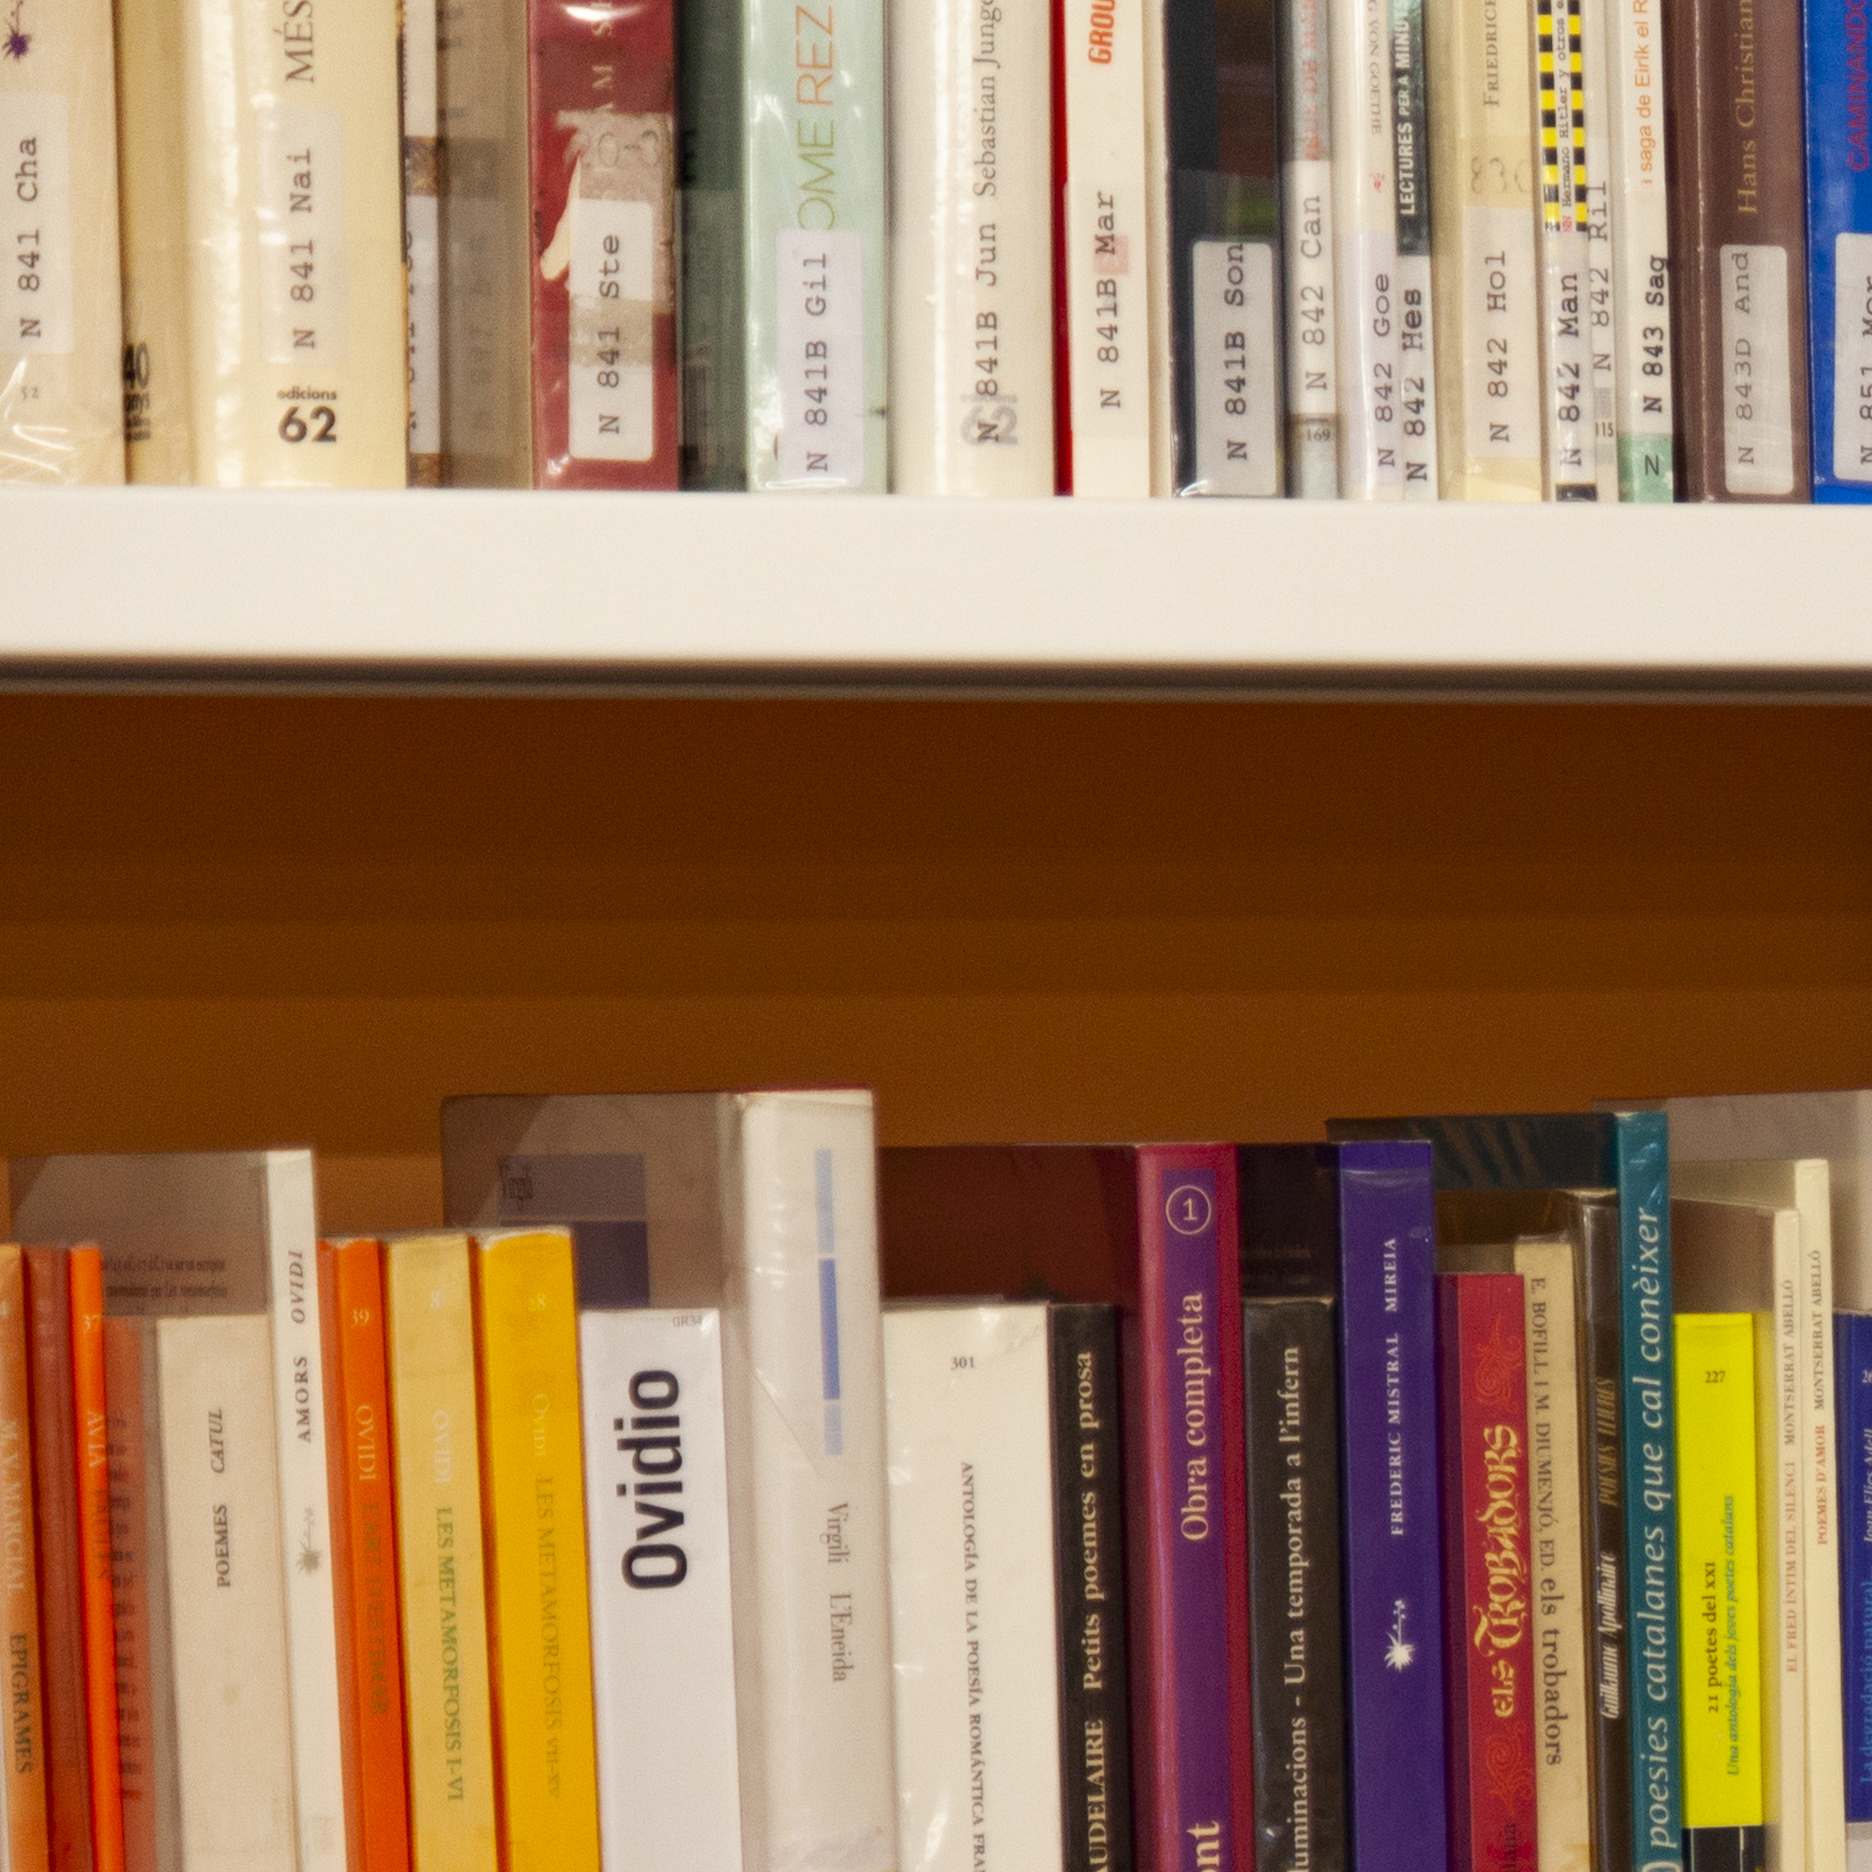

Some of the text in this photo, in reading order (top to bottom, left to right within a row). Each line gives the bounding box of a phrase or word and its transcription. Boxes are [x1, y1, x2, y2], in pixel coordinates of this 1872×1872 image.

[973, 76, 997, 197] Sebastian
[1737, 140, 1757, 213] Hans
[17, 137, 40, 338] N 841 Cha
[287, 148, 314, 347] N 841 Nai
[598, 235, 619, 433] N 841 Ste
[976, 223, 999, 442] N 841B Jun
[277, 387, 338, 402] edicions
[278, 407, 338, 444] 62
[802, 252, 827, 473] N 841B Gil
[1224, 243, 1247, 460] N 841B Son
[1401, 288, 1427, 481] N 842 Hes
[1556, 273, 1580, 467] N 842 Man
[1732, 252, 1754, 464] N 843D And
[613, 1368, 688, 1591] Ovidio
[1073, 1351, 1099, 1429] prosa
[1076, 1444, 1095, 1478] en
[1176, 1292, 1211, 1540] Obra completa
[1383, 1238, 1403, 1535] FREDERIC MISTRAL MIREIA
[1079, 1492, 1103, 1600] poemes
[1632, 1205, 1677, 1848] poesies catalanes que cal conèixer
[1080, 1614, 1102, 1690] Petits
